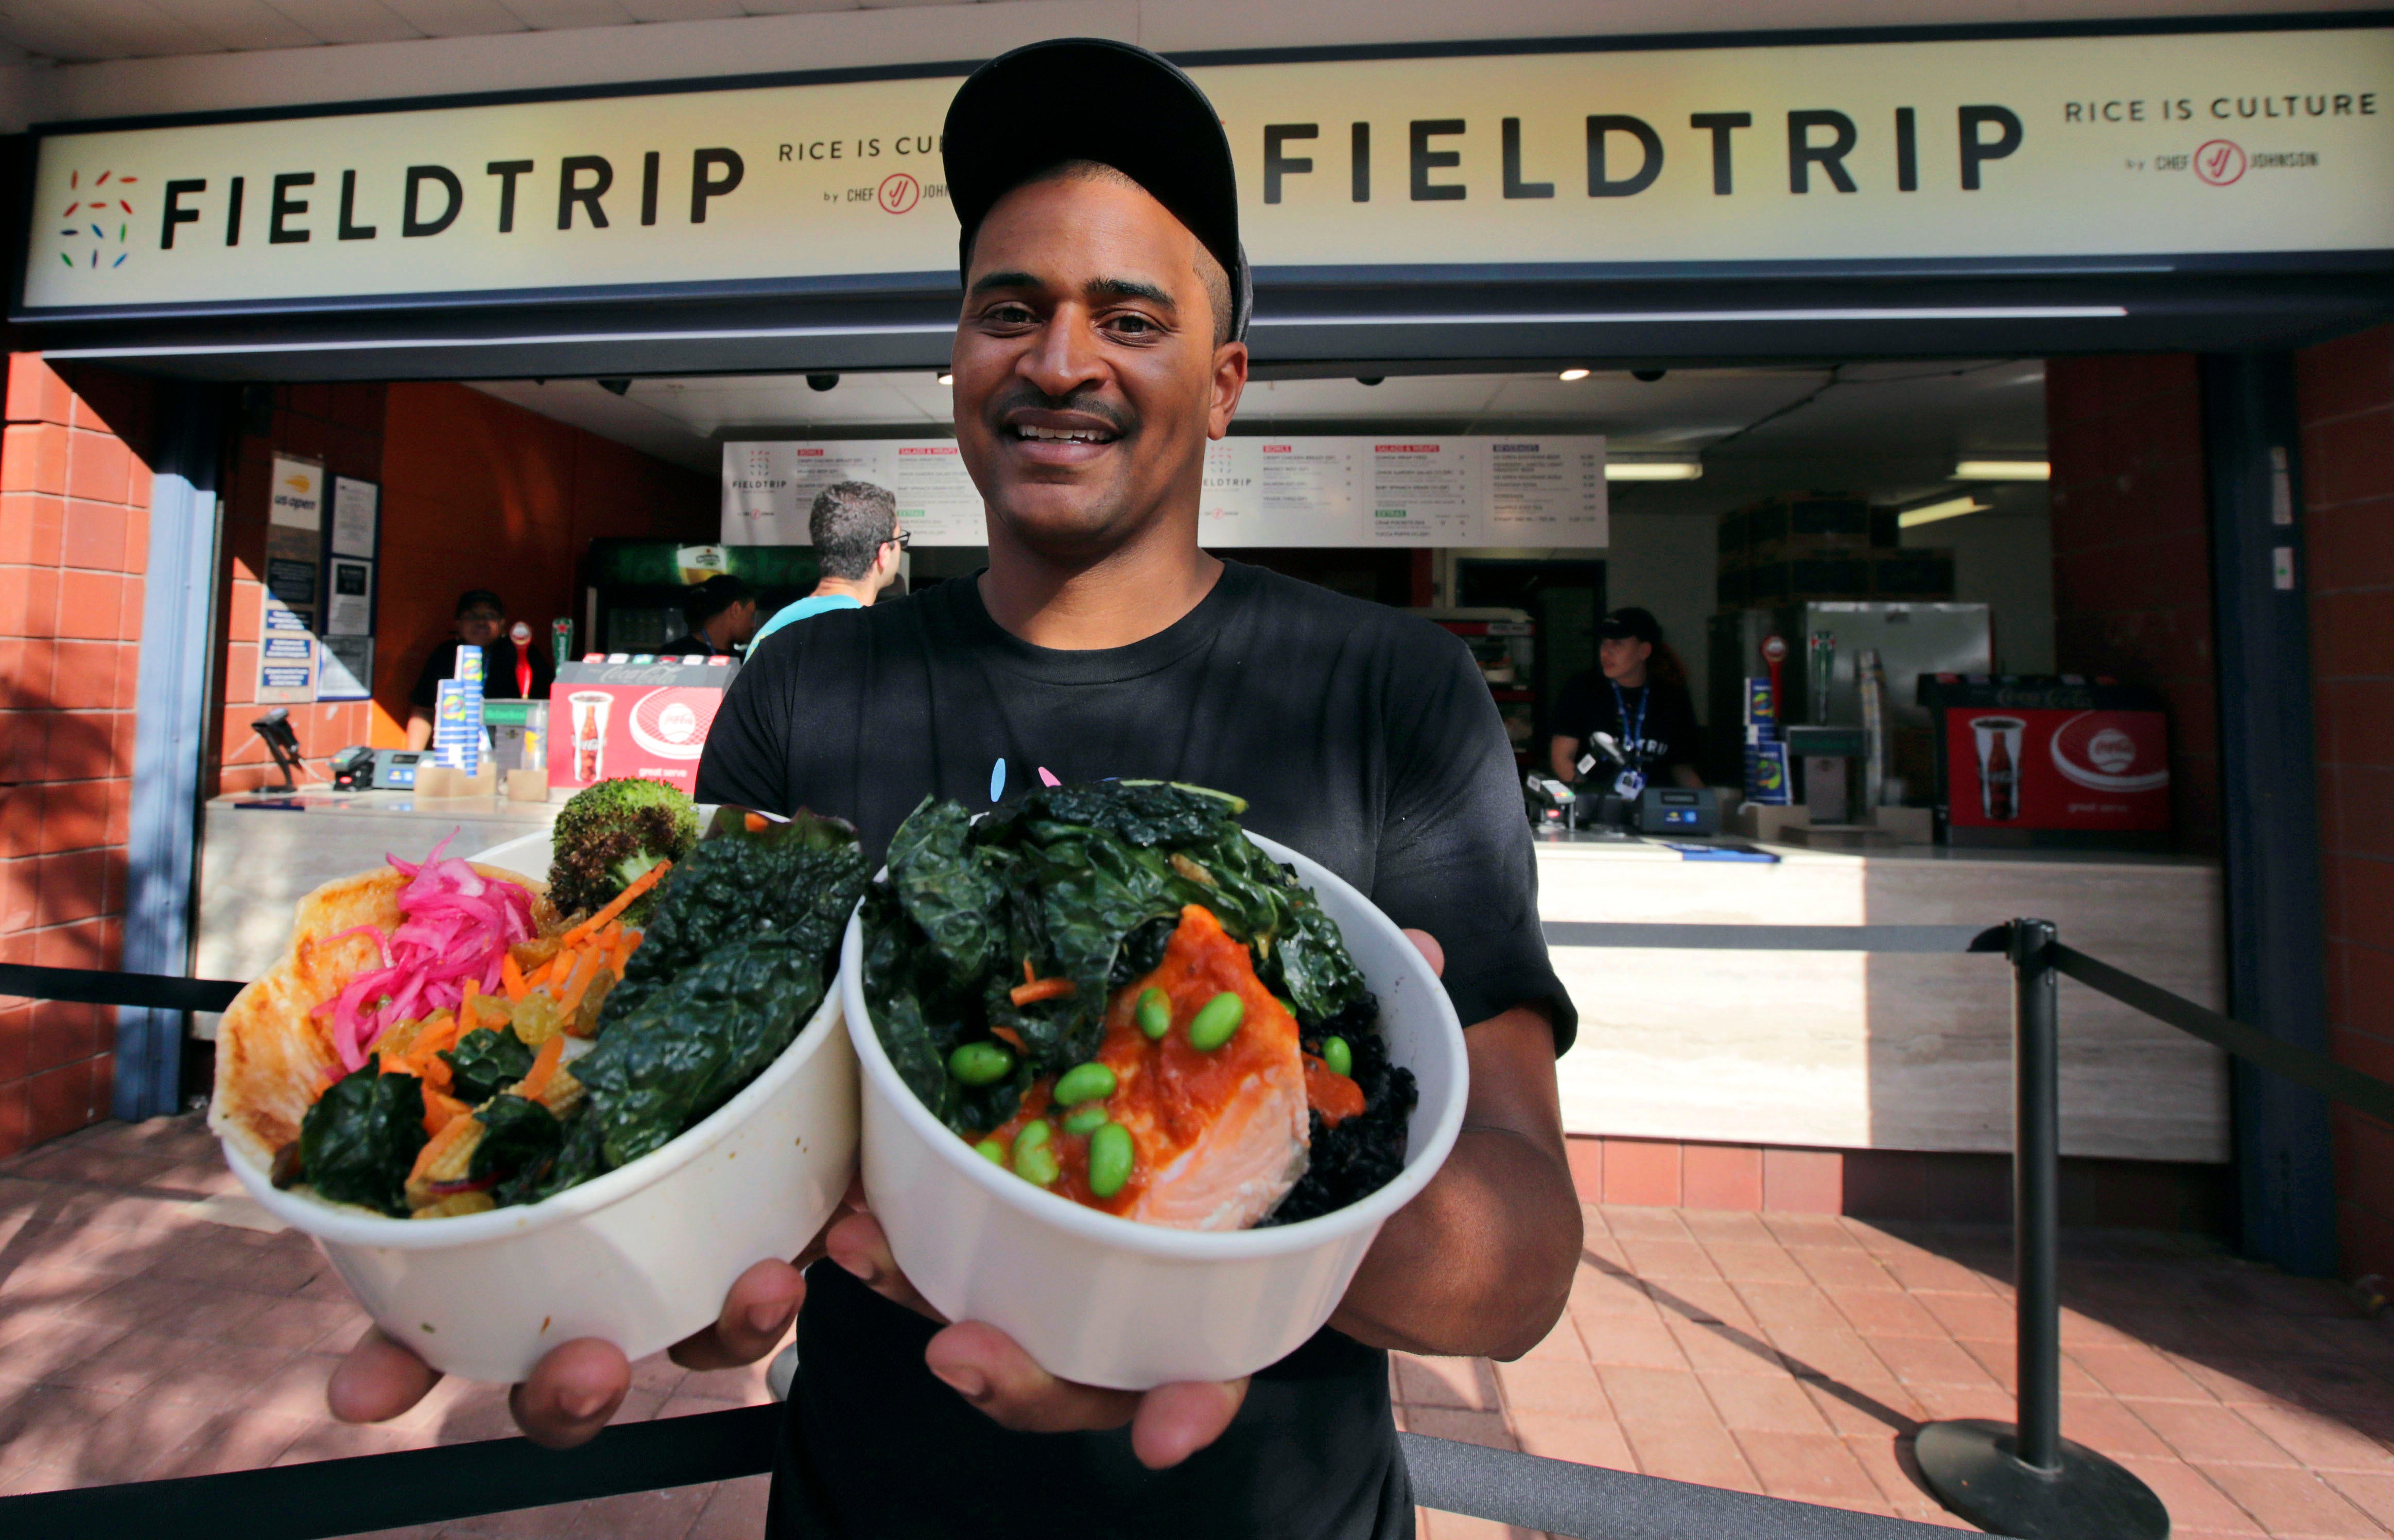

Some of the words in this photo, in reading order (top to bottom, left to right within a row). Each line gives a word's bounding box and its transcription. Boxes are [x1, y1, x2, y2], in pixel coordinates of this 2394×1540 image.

[2064, 100, 2145, 122] RICE
[2162, 98, 2193, 120] IS
[2210, 91, 2378, 119] CULTURE
[778, 141, 843, 162] RICE
[857, 138, 880, 157] IS
[1263, 104, 2024, 204] FIELDTRIP
[2155, 154, 2189, 170] CHEF
[2251, 151, 2320, 168] JOHNSON
[160, 147, 744, 250] FIELDTRIP
[823, 192, 839, 202] by
[847, 187, 874, 202] CHEF
[733, 480, 787, 488] FIELDTRIP
[1203, 478, 1252, 486] ELDTRIP
[274, 495, 287, 505] us
[288, 497, 316, 510] open
